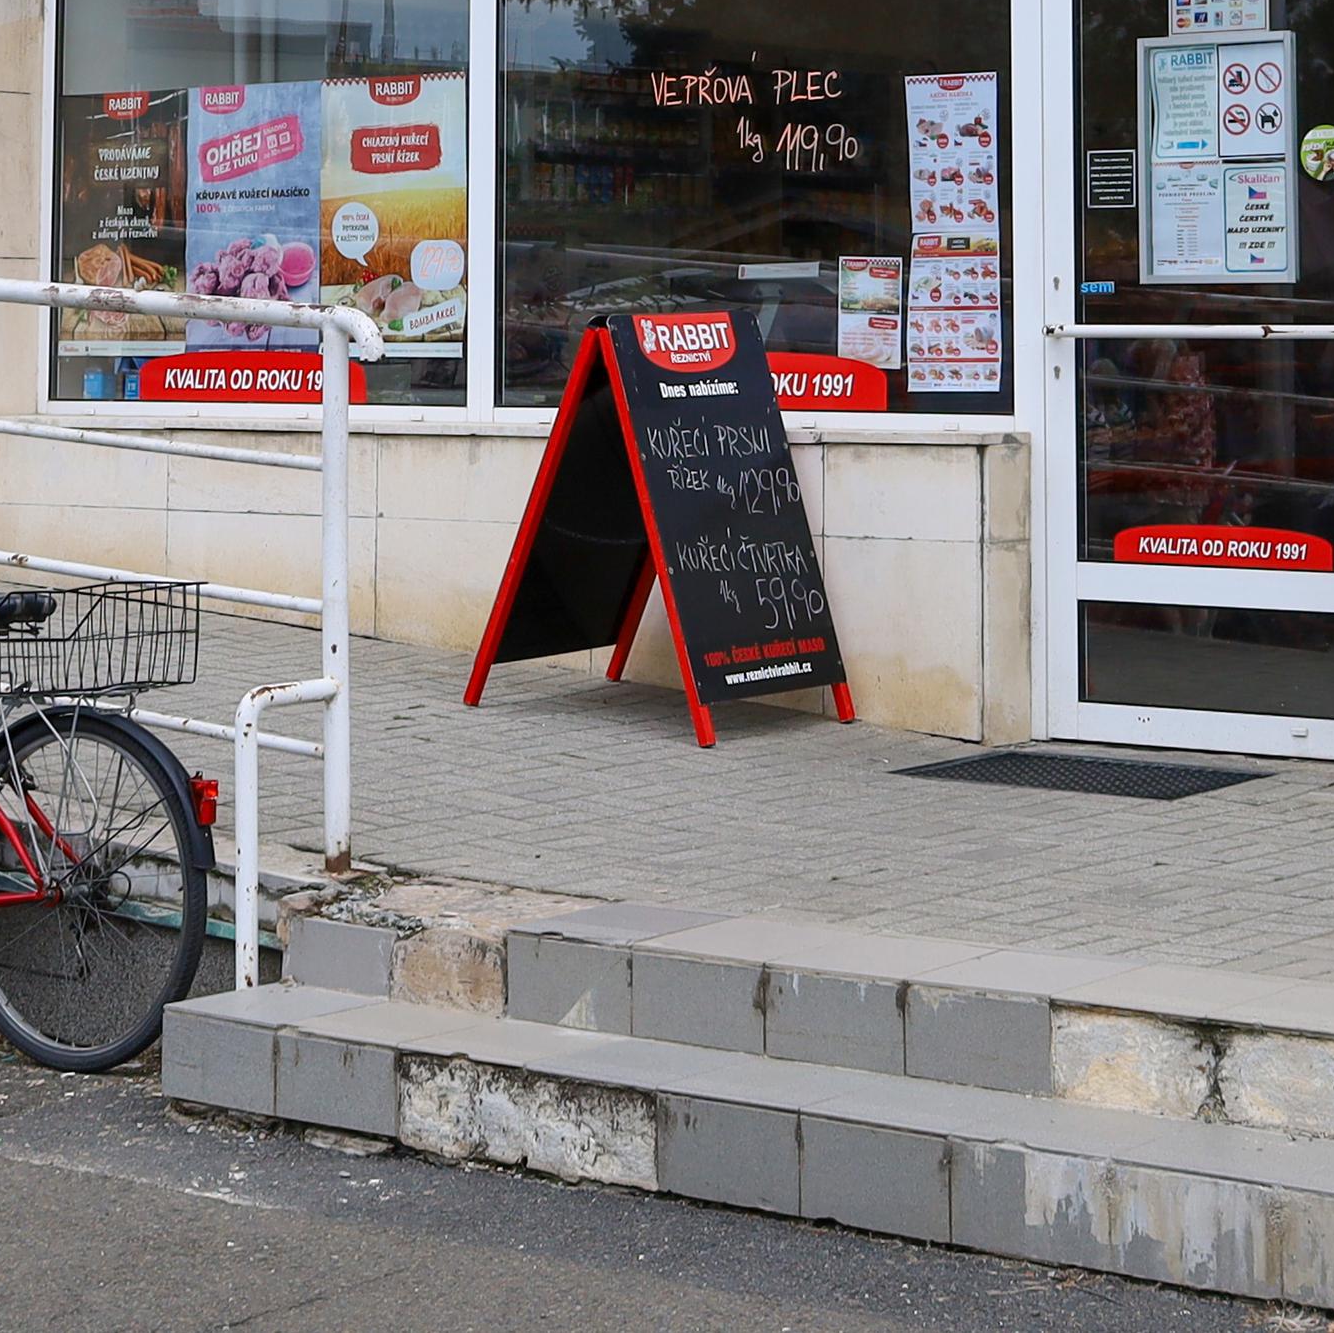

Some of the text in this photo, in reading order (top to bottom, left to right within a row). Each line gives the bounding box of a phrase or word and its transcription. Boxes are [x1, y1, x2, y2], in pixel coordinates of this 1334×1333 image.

[1171, 51, 1214, 67] RABBIT
[375, 80, 415, 97] RABBIT
[651, 51, 842, 107] VEPŘOVÁ PLEC
[108, 97, 143, 111] RABBIT
[205, 91, 240, 106] RABBIT
[206, 130, 262, 166] OHŘEJ
[362, 130, 429, 148] CHLAZENÝ KUŘECÍ
[736, 115, 764, 163] 1kg
[98, 143, 152, 162] PRODÁVÁME
[371, 148, 420, 165] PRSNÍ ŘÍZEK
[94, 164, 119, 181] ČESKÉ
[213, 161, 232, 176] BEZ
[233, 152, 259, 170] TUKU
[239, 187, 270, 199] KUŘECÍ
[271, 186, 310, 198] MASÍČKO
[196, 204, 221, 214] 100%
[1244, 202, 1270, 211] ČESKÉ
[1248, 241, 1265, 249] ZDE
[1080, 282, 1113, 295] sem
[409, 305, 457, 330] BOMBA AKCE!
[657, 321, 730, 353] RABBIT
[671, 350, 712, 365] ŘEZNICTVÍ
[165, 368, 323, 391] KVALITA OD ROKU 19
[659, 378, 740, 399] Dnes nabízíme:
[772, 372, 855, 398] OKU 1991
[646, 415, 772, 460] KUŘECÍ PRSNÍ
[667, 462, 712, 492] ŘÍZEK
[676, 526, 809, 576] KUŘECÍ ČTVRTKA
[1138, 536, 1308, 561] KVALITA OD ROKU 1991
[756, 577, 825, 631] 59,90
[703, 636, 826, 668] 100% ČESKÉ KUŘECÍ MASO
[724, 662, 813, 686] www.reznictvirabbit.cz
